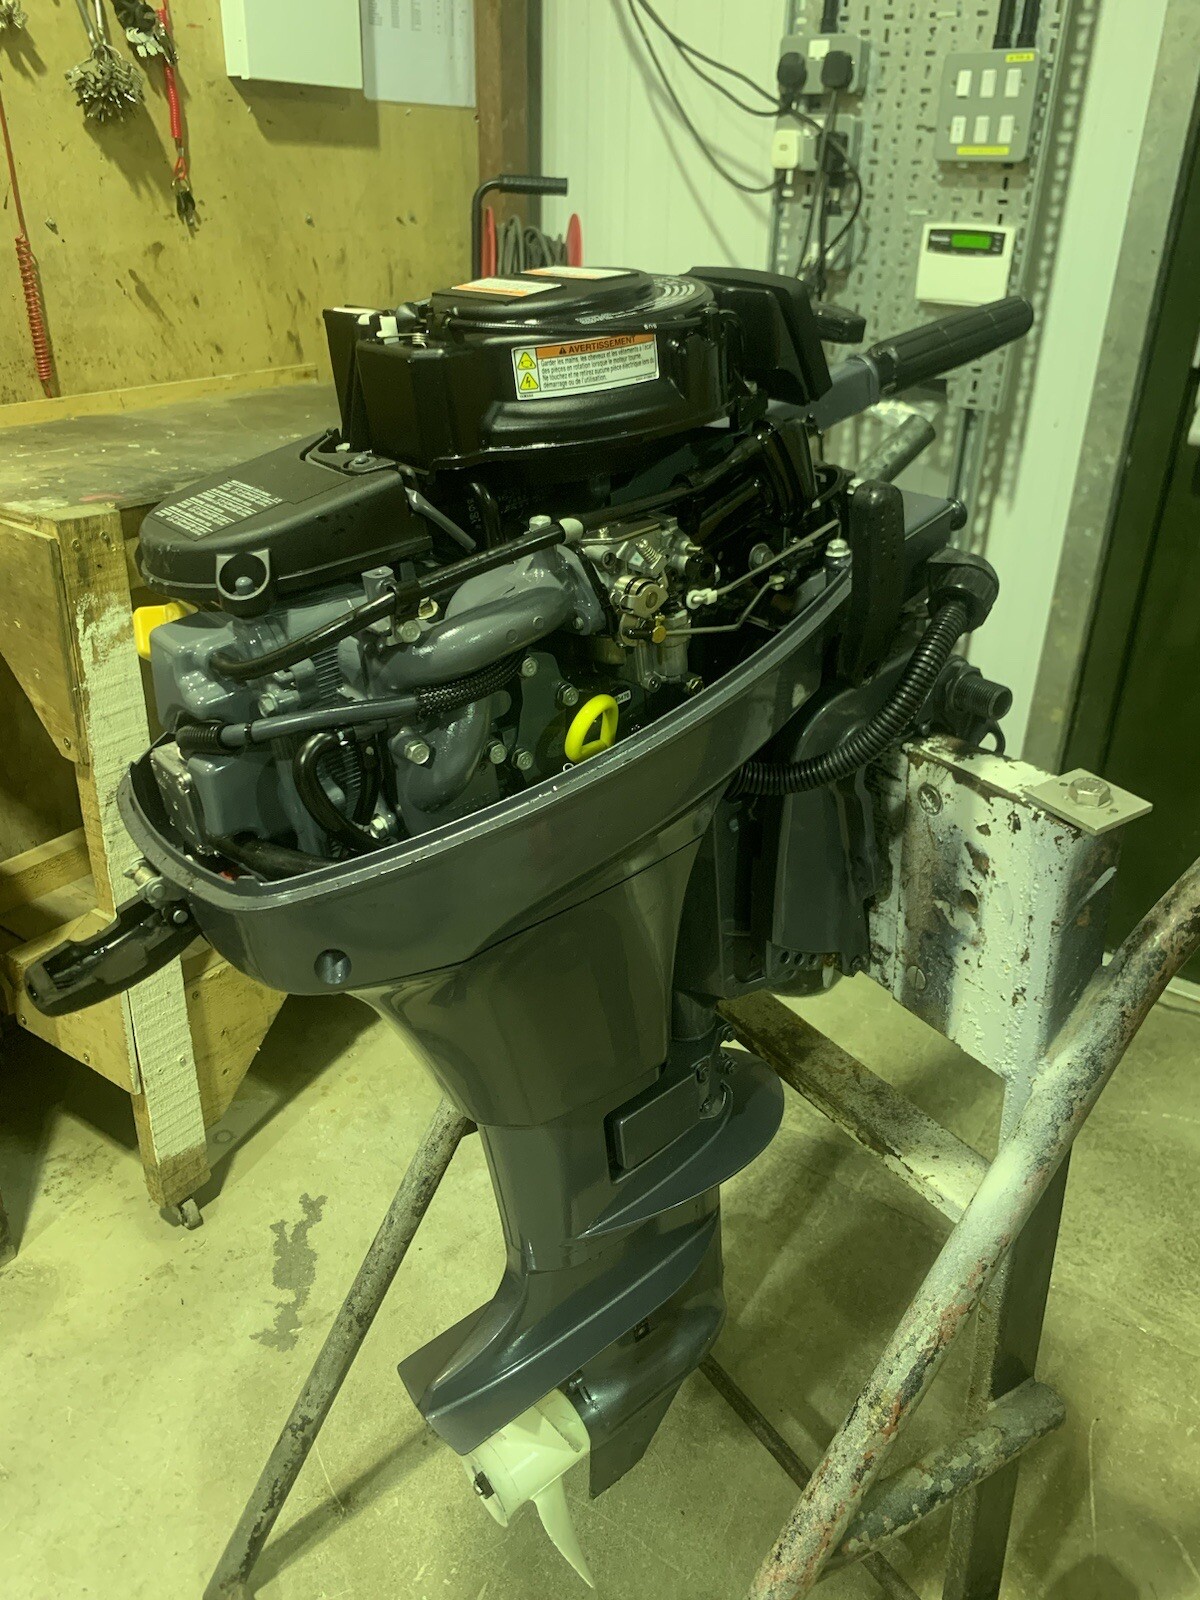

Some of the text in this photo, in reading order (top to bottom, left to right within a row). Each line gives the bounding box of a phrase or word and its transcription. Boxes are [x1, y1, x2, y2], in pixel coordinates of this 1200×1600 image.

[569, 336, 635, 353] AVERTISSEMENT
[541, 358, 556, 367] Garder
[588, 352, 606, 361] cheveux
[618, 346, 639, 356] vêtements
[550, 366, 566, 375] pièces
[573, 360, 590, 370] rotation
[592, 359, 608, 368] lorsque
[550, 372, 568, 380] touchez
[580, 368, 594, 377] retirez
[594, 366, 610, 374] aucune
[610, 364, 622, 374] pièce
[622, 360, 642, 370] électrique
[544, 380, 568, 390] démarrage
